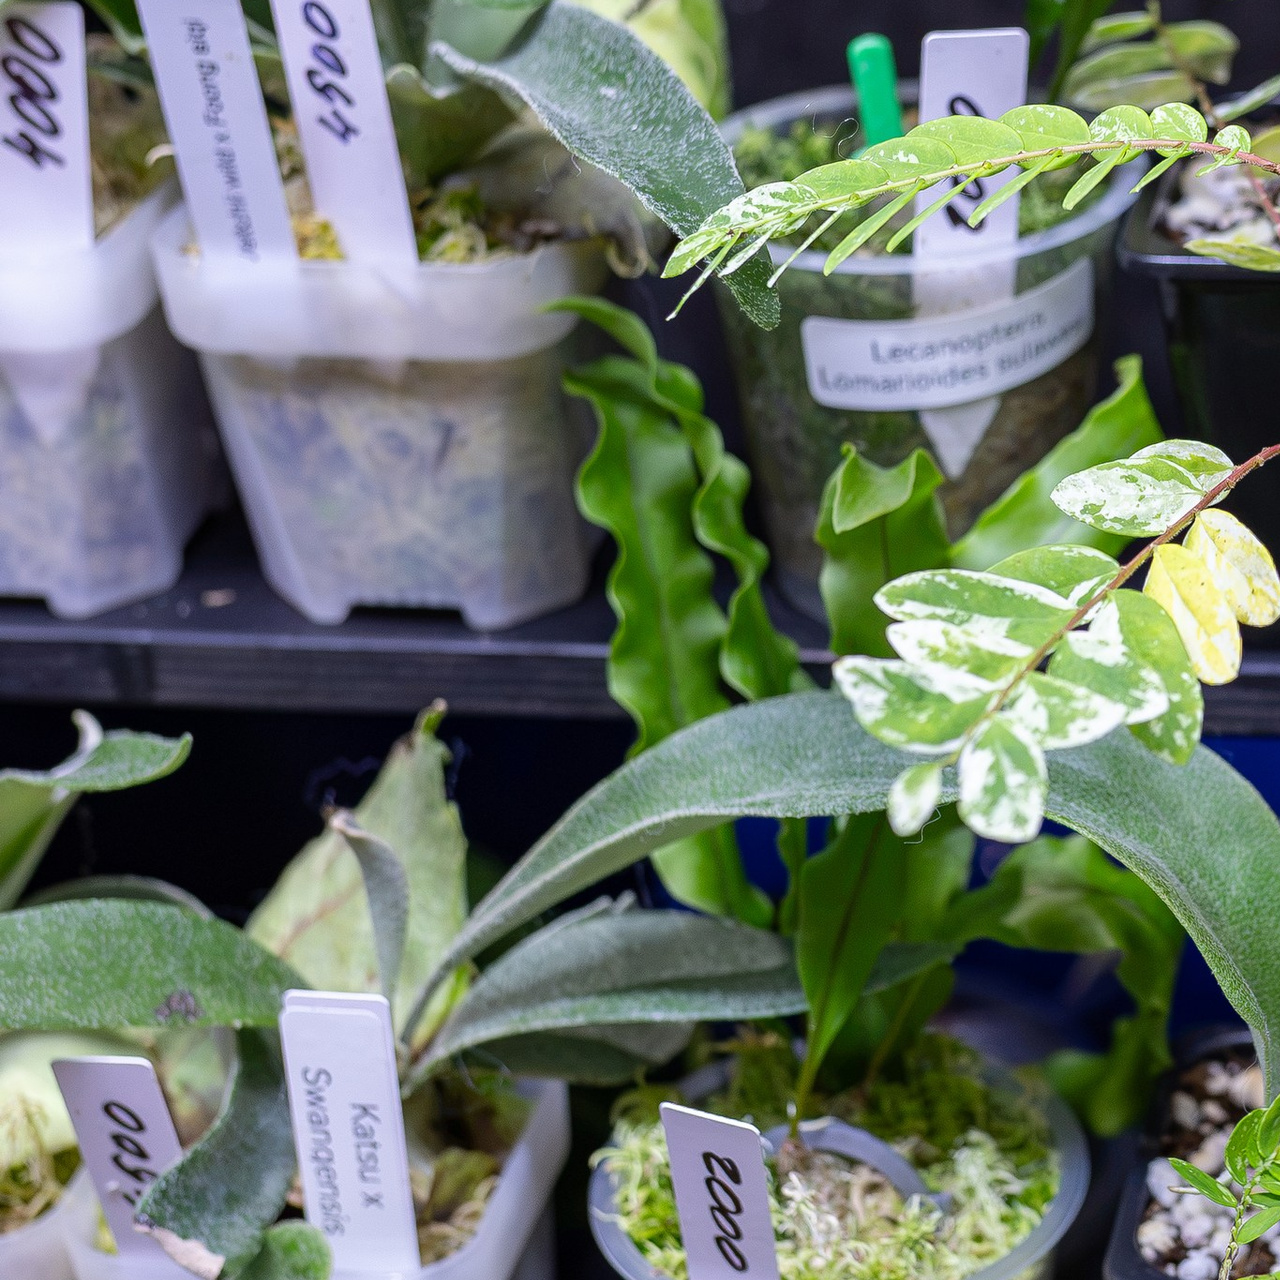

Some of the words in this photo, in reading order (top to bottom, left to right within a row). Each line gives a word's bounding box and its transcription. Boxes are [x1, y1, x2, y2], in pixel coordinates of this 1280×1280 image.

[350, 1102, 383, 1185] Katsu
[360, 1190, 385, 1210] x
[702, 1151, 749, 1272] 2000
